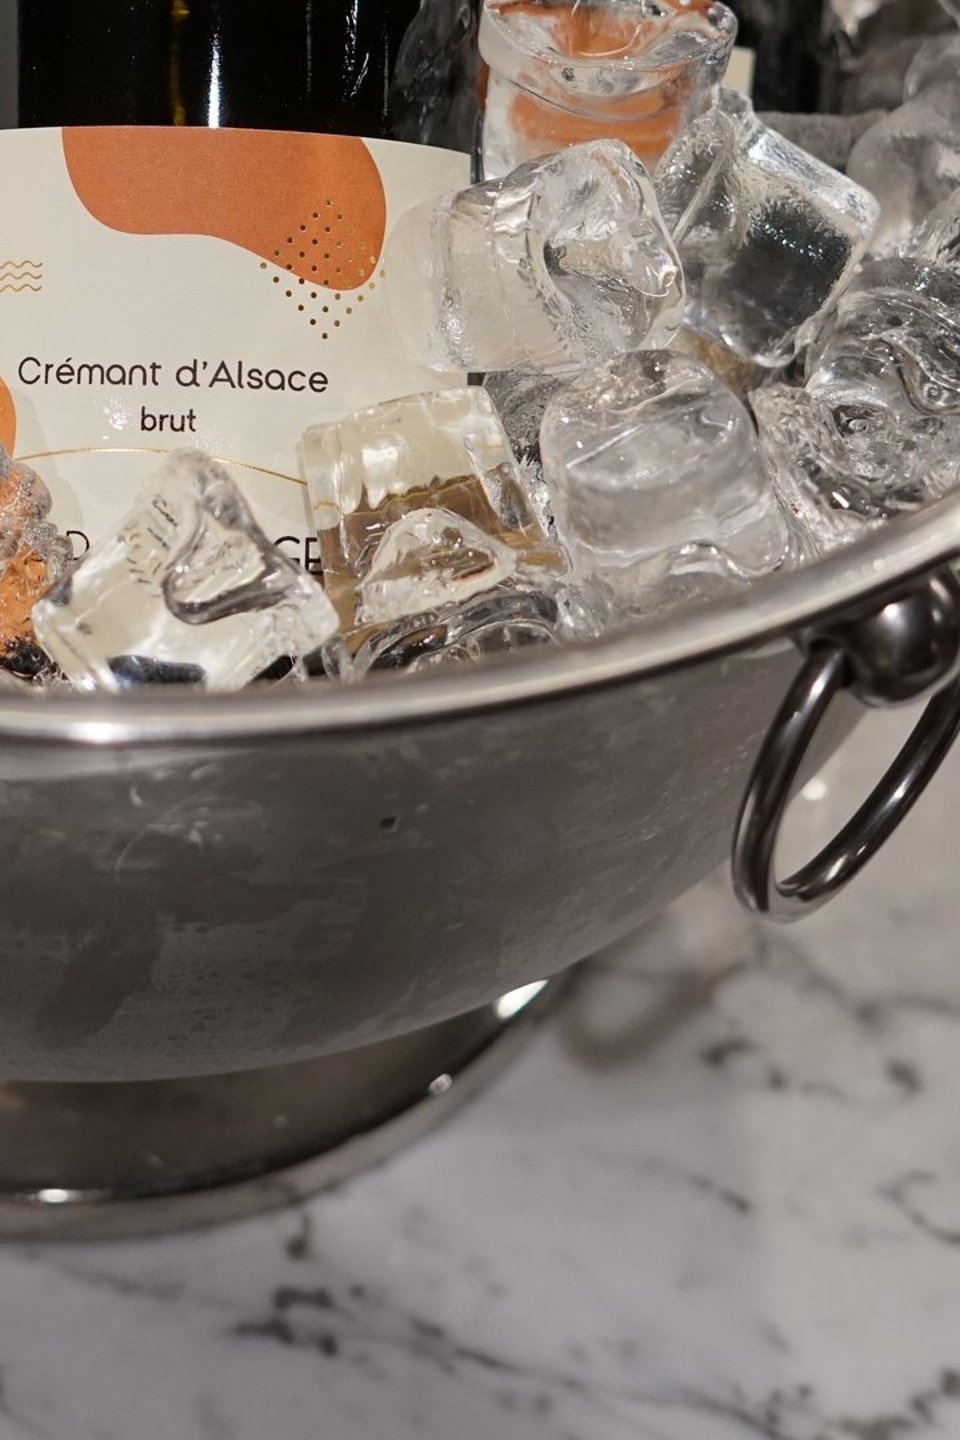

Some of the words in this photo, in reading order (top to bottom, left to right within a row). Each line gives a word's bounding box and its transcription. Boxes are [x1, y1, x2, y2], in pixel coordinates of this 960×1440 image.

[17, 355, 163, 387] Crémant
[174, 358, 330, 393] d'Alsace
[139, 406, 198, 433] brut
